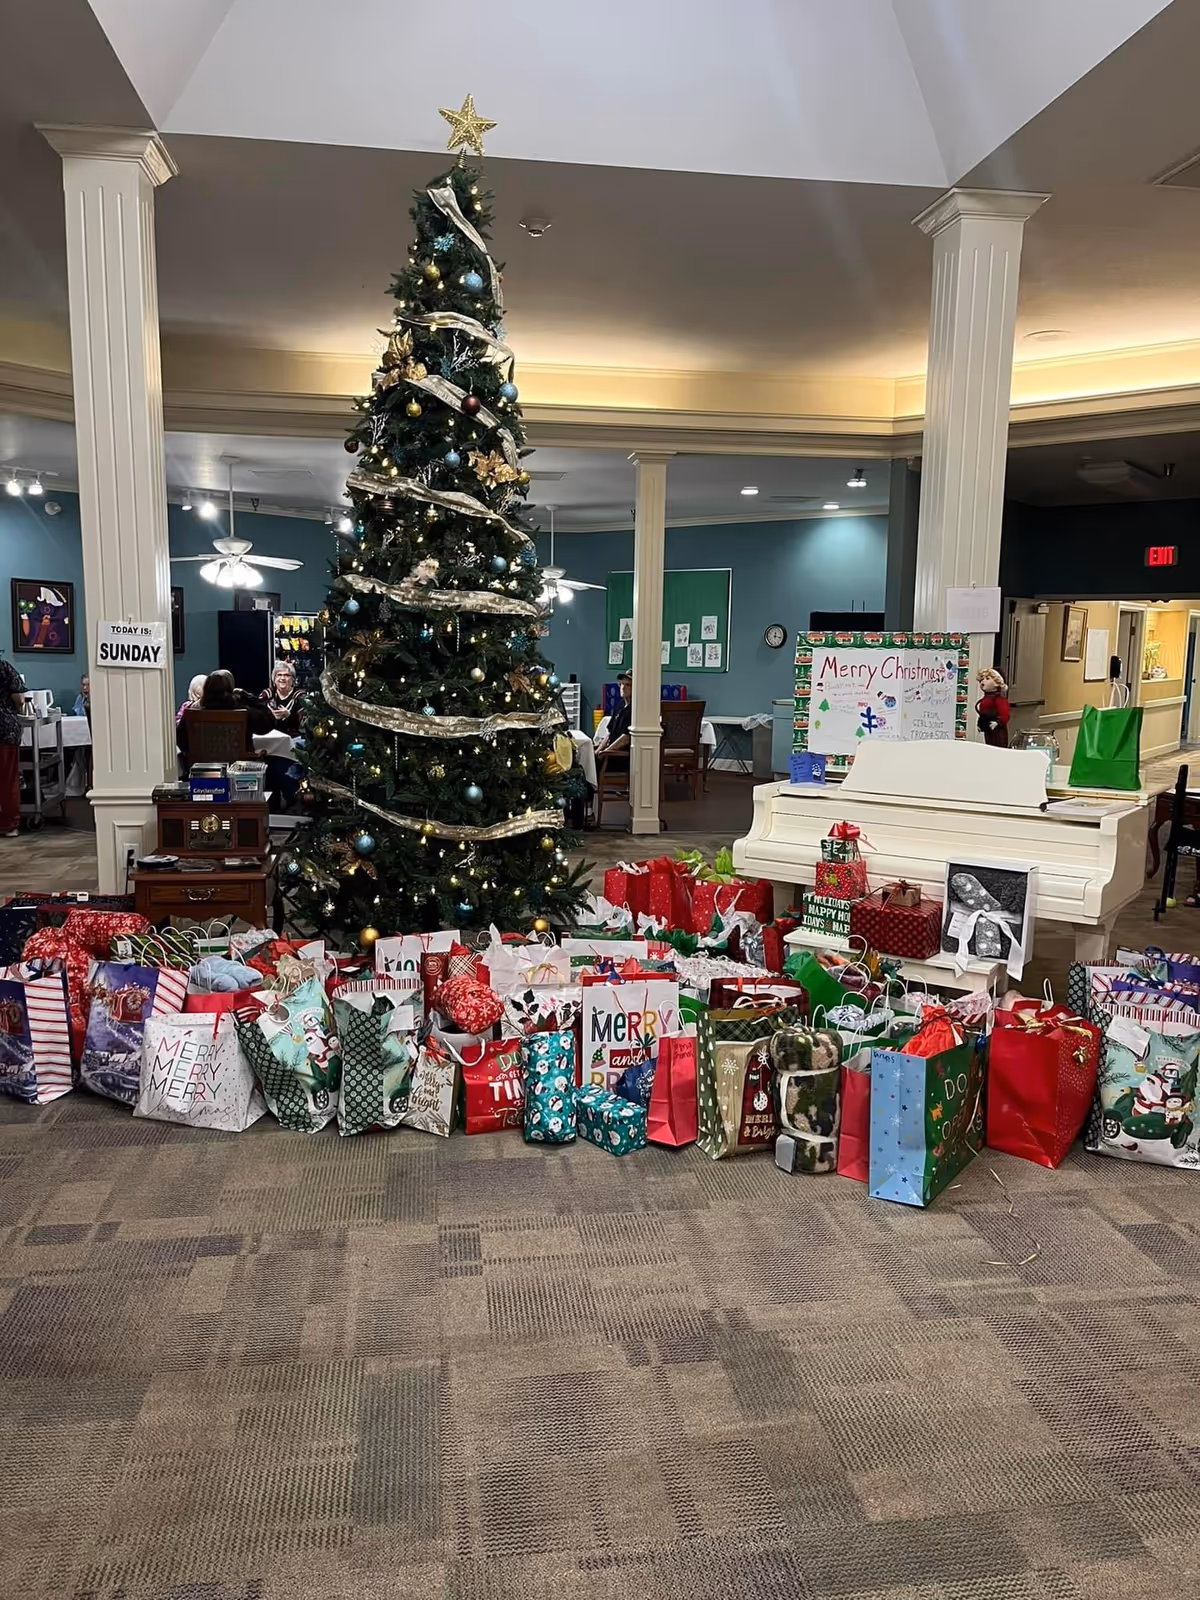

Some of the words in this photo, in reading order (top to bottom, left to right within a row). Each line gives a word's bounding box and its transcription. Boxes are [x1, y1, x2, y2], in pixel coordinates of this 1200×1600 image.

[1149, 546, 1175, 566] EXIT
[111, 625, 138, 634] TODAY
[141, 627, 152, 635] IS:
[100, 642, 161, 663] SUNDAY
[820, 655, 877, 690] Merry
[880, 655, 940, 680] Christmas
[801, 914, 825, 928] IDAYS
[808, 904, 837, 919] HAPPY
[157, 1036, 224, 1062] MERRY
[611, 1049, 644, 1067] and
[152, 1055, 222, 1081] MERRY
[149, 1074, 222, 1100] MERRY
[944, 1073, 967, 1100] DO
